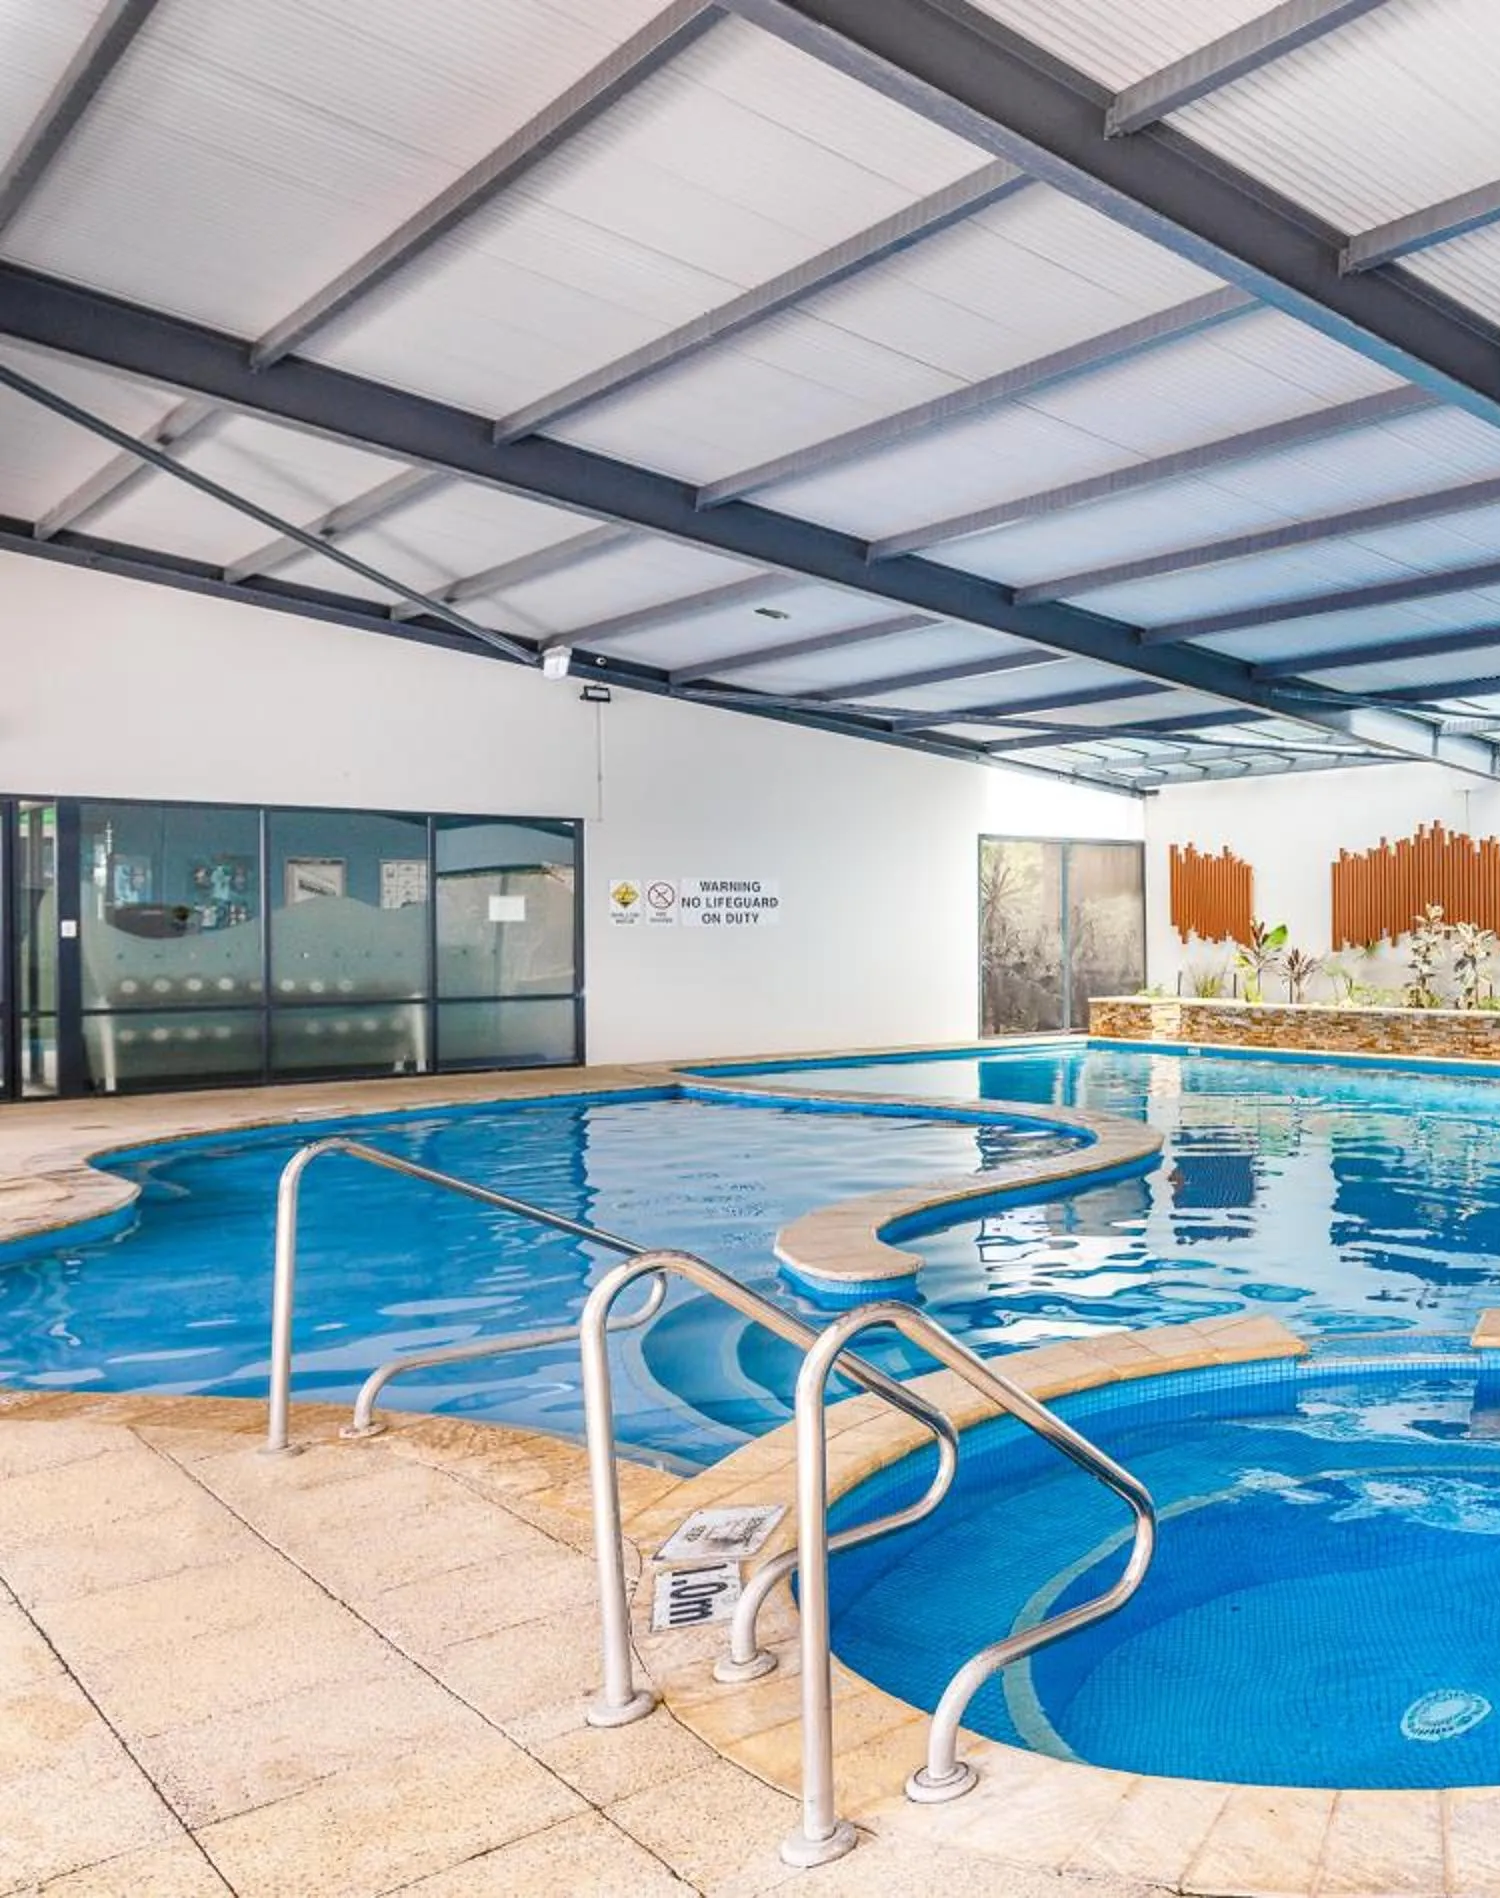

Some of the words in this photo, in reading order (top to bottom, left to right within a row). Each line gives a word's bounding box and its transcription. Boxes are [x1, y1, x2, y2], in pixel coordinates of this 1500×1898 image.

[699, 881, 761, 893] WARNING
[681, 897, 701, 909] NO
[705, 897, 779, 909] LIFEGUARD
[701, 913, 721, 925] ON
[725, 913, 759, 925] DUTY
